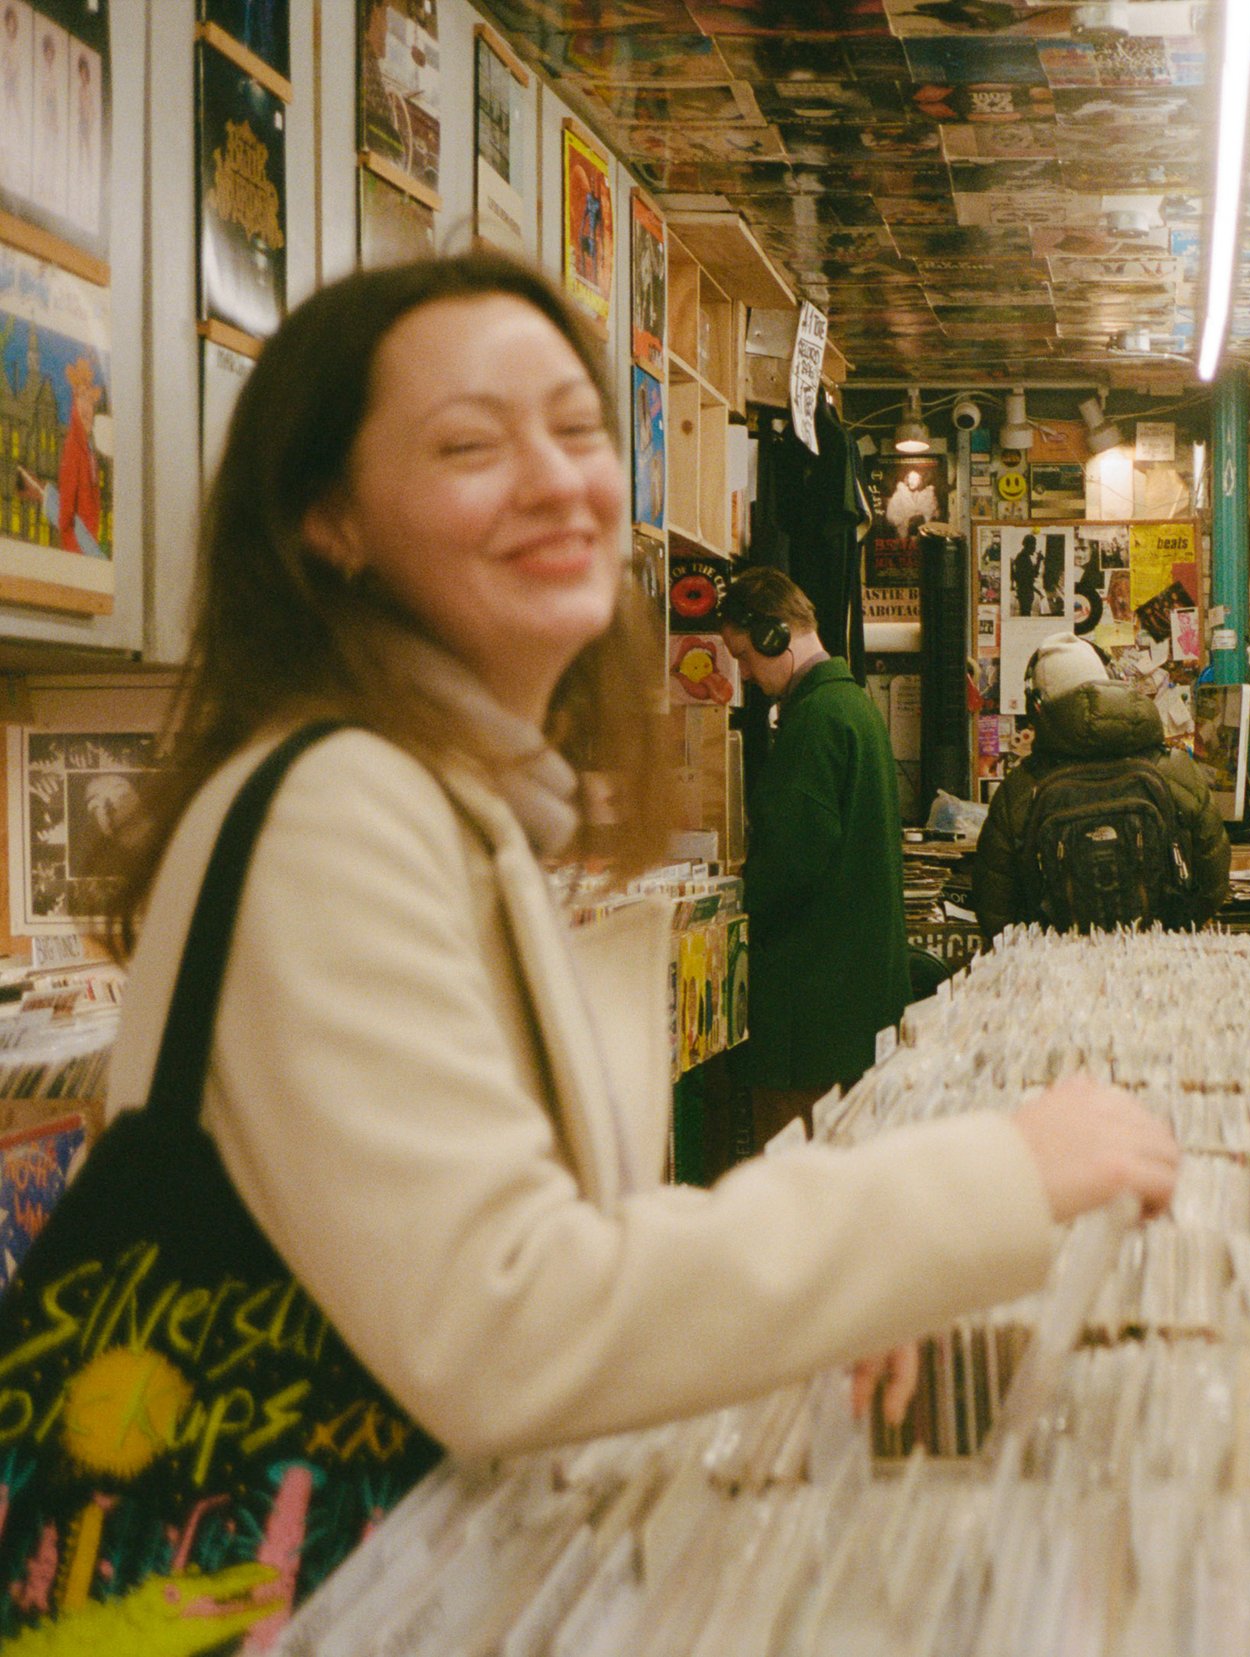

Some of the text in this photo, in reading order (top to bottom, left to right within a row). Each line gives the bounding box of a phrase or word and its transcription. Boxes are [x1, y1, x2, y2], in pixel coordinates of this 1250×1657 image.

[1157, 536, 1189, 550] beats
[692, 563, 717, 577] THE
[864, 588, 905, 600] ASTIE
[862, 605, 919, 617] SABOTAG
